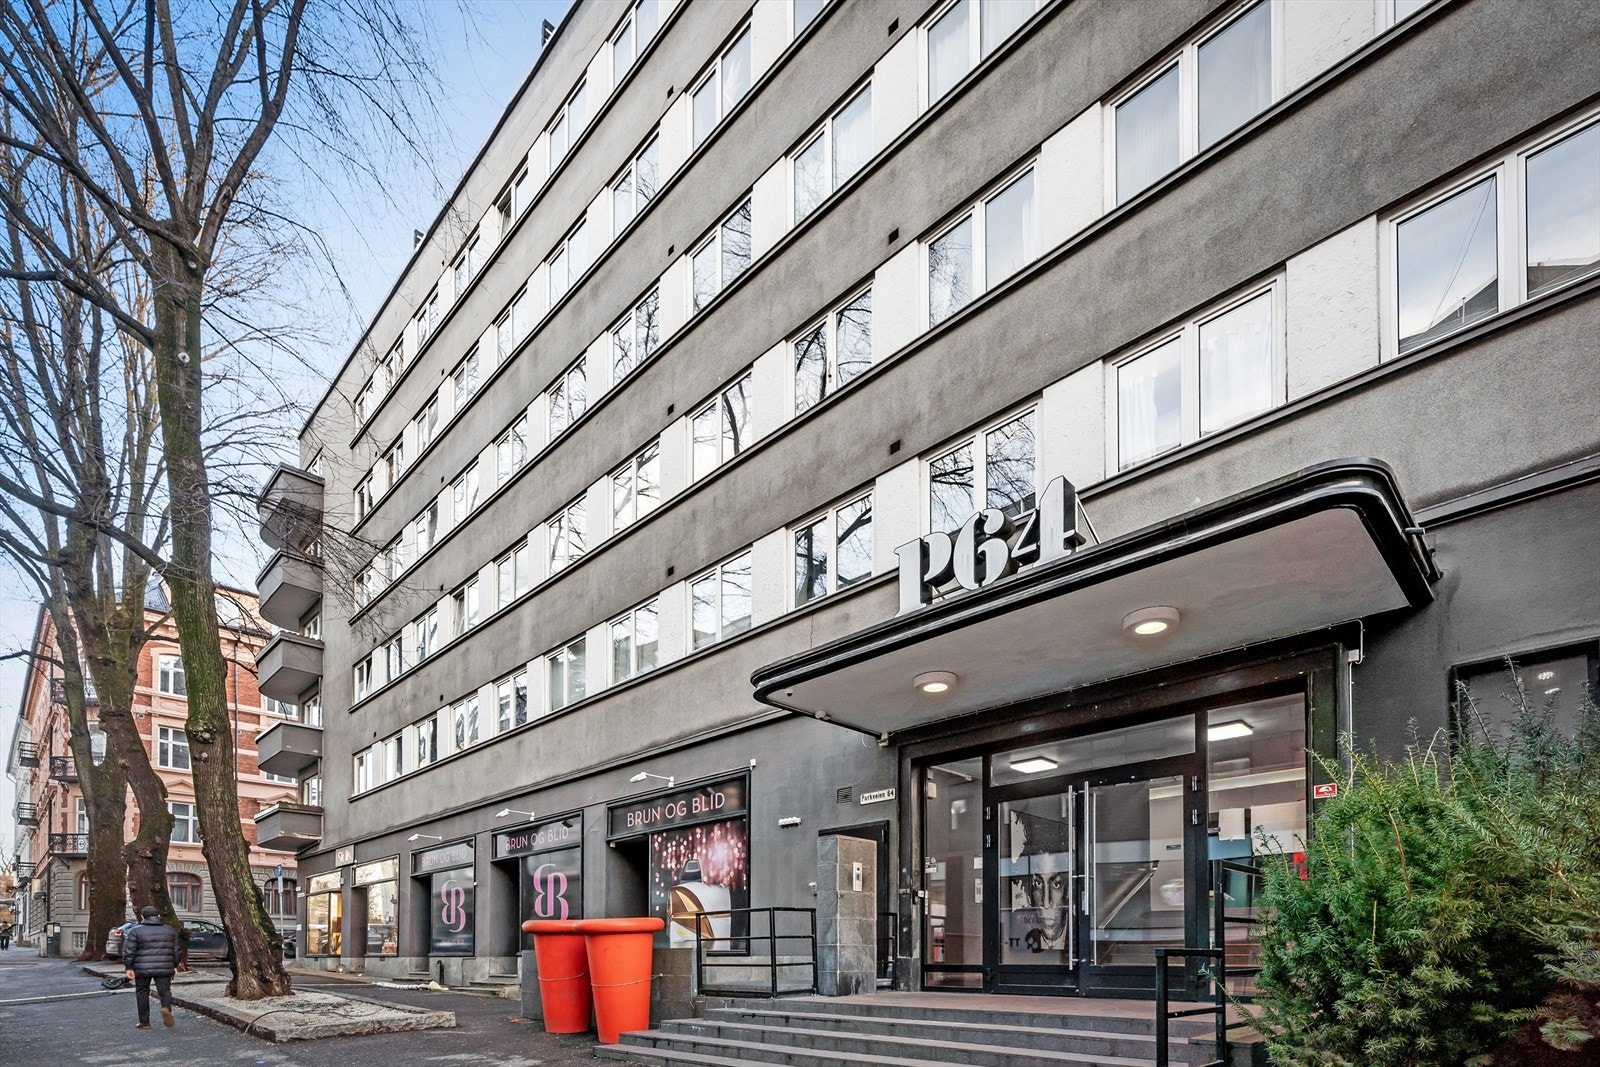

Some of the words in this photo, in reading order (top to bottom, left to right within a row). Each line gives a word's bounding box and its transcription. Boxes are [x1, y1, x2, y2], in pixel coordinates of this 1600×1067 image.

[893, 475, 1083, 618] P64
[627, 806, 661, 827] BRUN
[665, 800, 687, 819] OG
[692, 792, 725, 814] BLID
[505, 834, 528, 851] BRUN
[530, 831, 545, 846] OG
[547, 826, 569, 842] BLID
[421, 855, 438, 867] BRUN
[440, 852, 450, 864] OG
[451, 848, 467, 861] BLID
